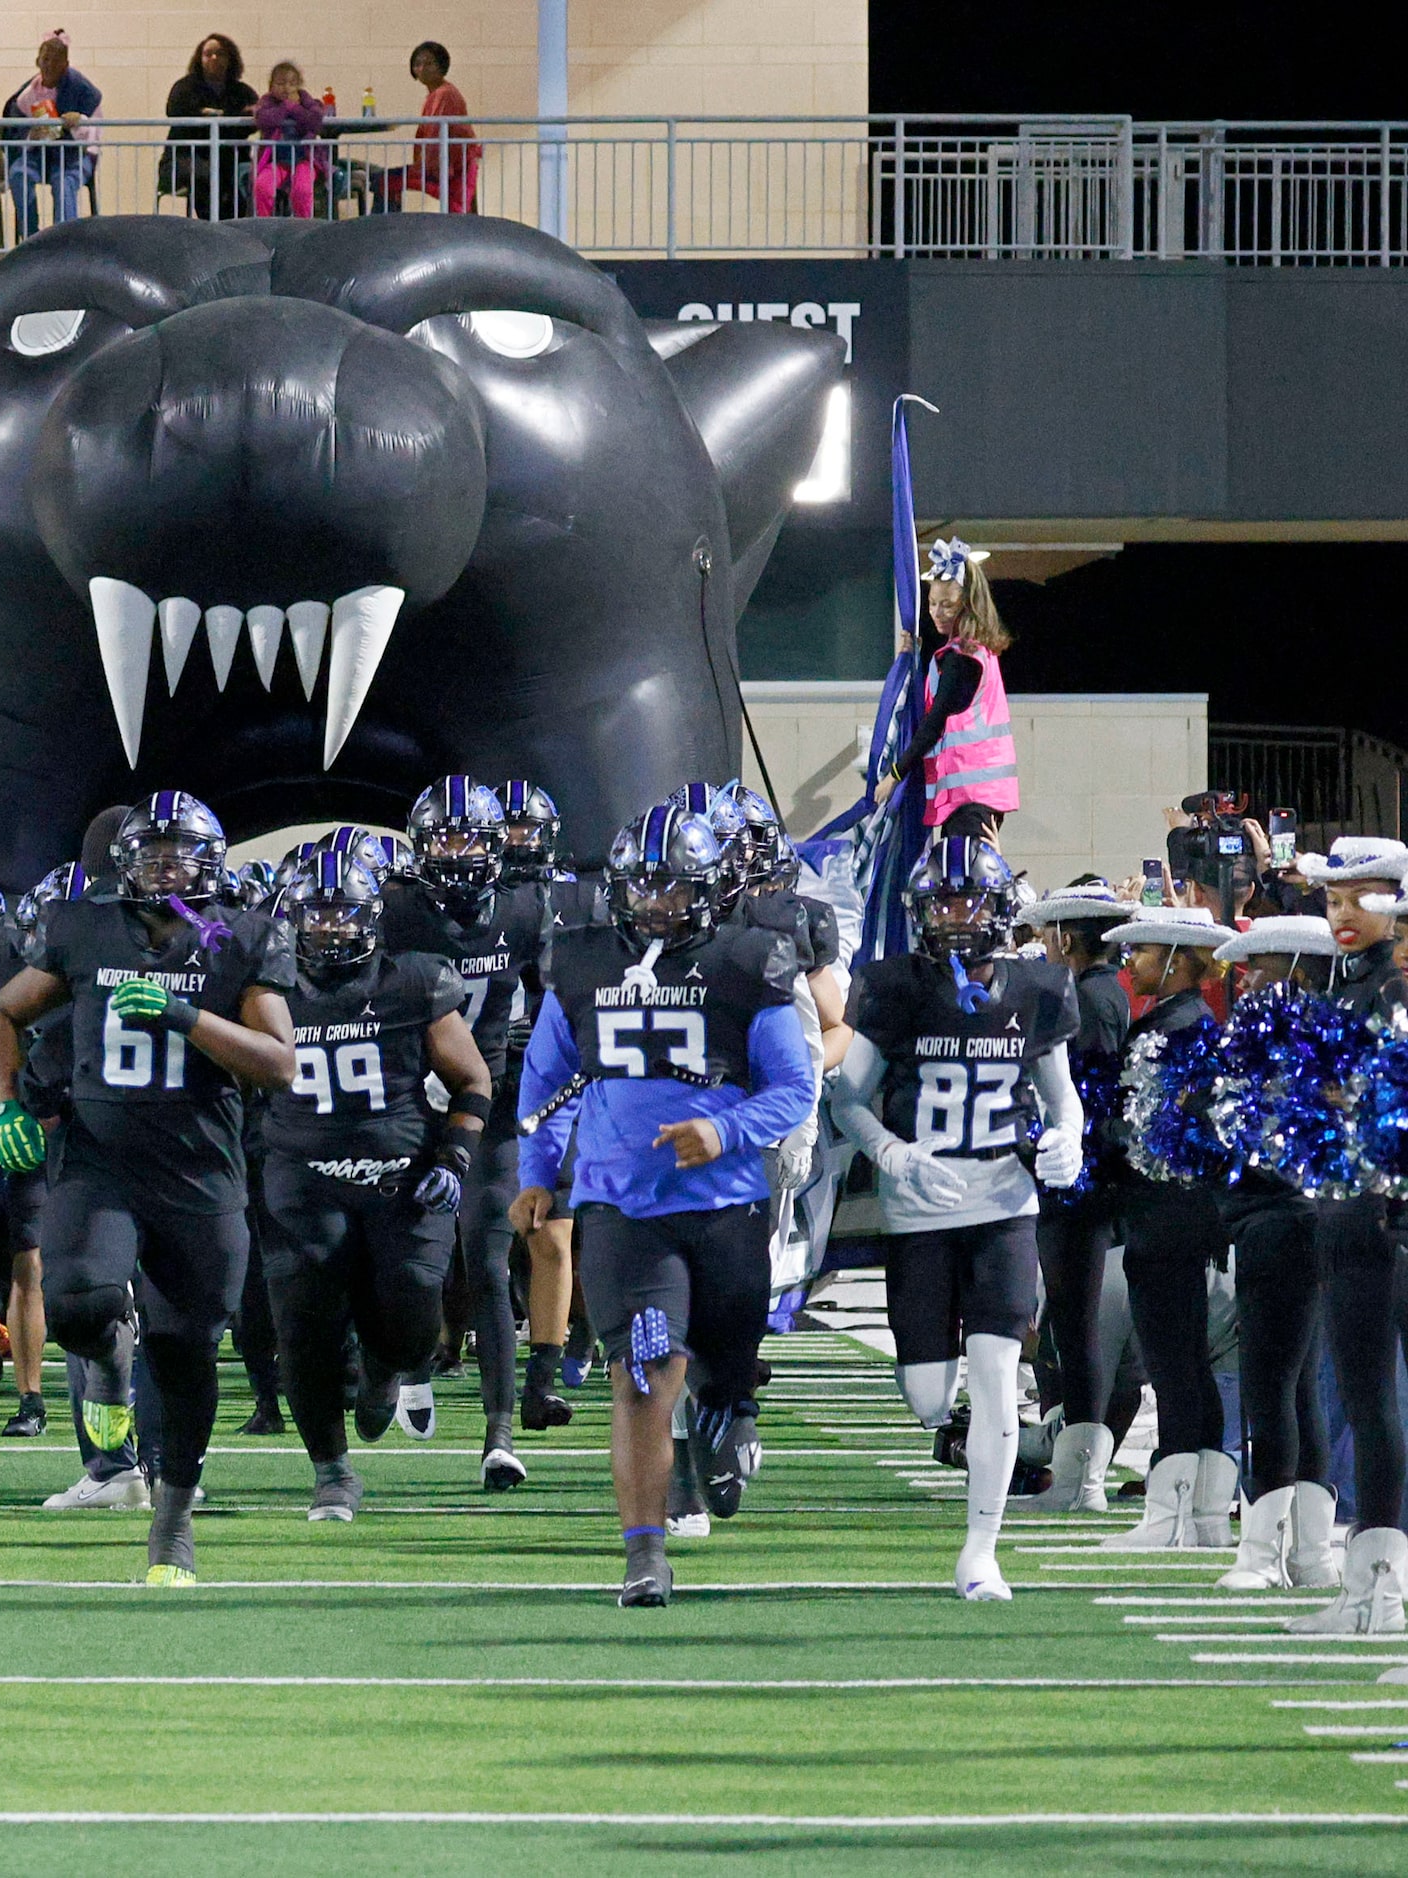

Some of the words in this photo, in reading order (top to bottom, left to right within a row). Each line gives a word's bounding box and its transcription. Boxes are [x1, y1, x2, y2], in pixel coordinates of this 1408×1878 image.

[460, 952, 511, 975] CROWLEY
[293, 1025, 322, 1044] ORTH
[325, 1021, 381, 1042] CROWLEY
[463, 977, 490, 1032] 7
[103, 994, 189, 1088] 61
[597, 1010, 707, 1078] 53
[915, 1036, 961, 1058] NORTH
[966, 1037, 1026, 1058] CROWLEY
[292, 1042, 386, 1114] 99
[915, 1061, 1021, 1151] 82
